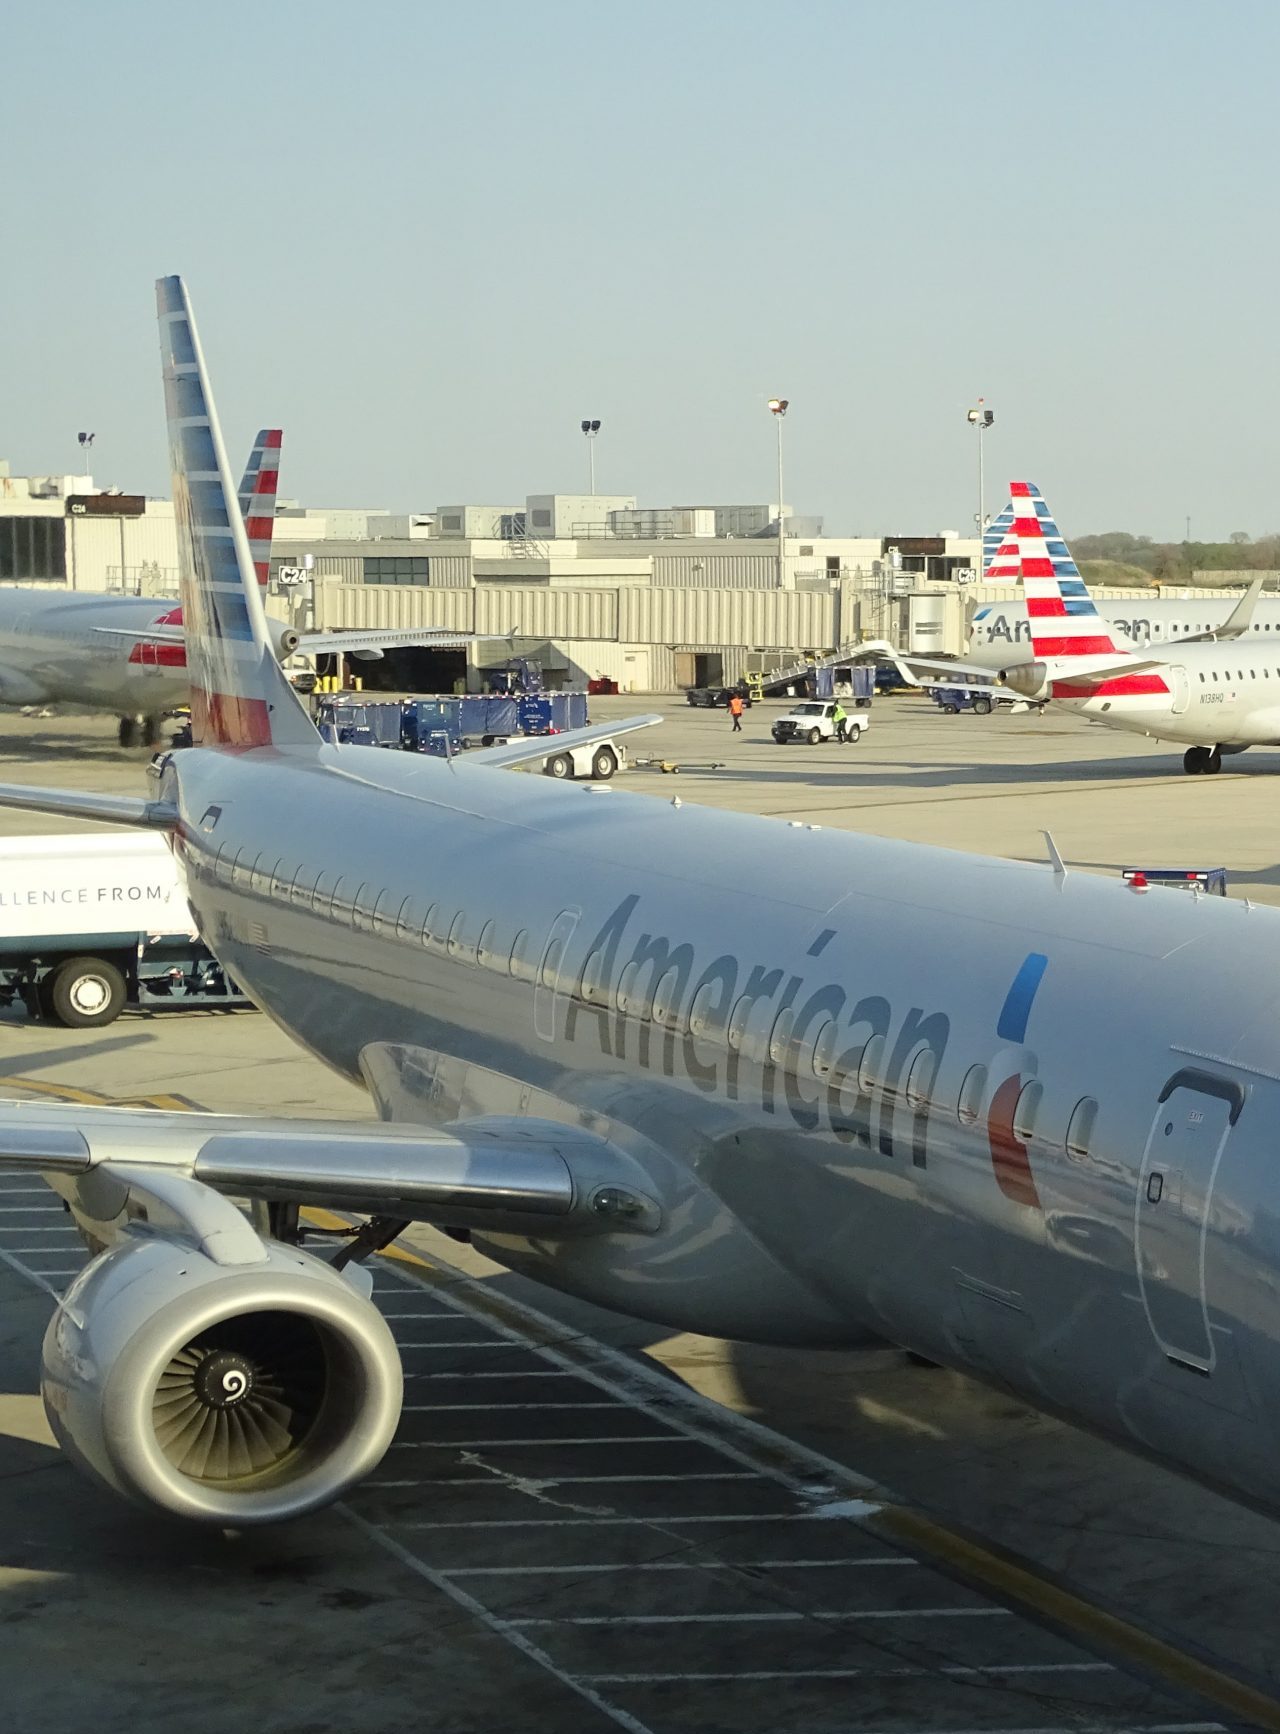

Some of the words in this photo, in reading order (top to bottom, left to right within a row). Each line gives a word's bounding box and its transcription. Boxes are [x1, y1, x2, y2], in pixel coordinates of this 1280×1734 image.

[281, 567, 308, 584] C24
[958, 568, 976, 584] C26
[97, 884, 162, 902] FROM
[564, 893, 952, 1171] American
